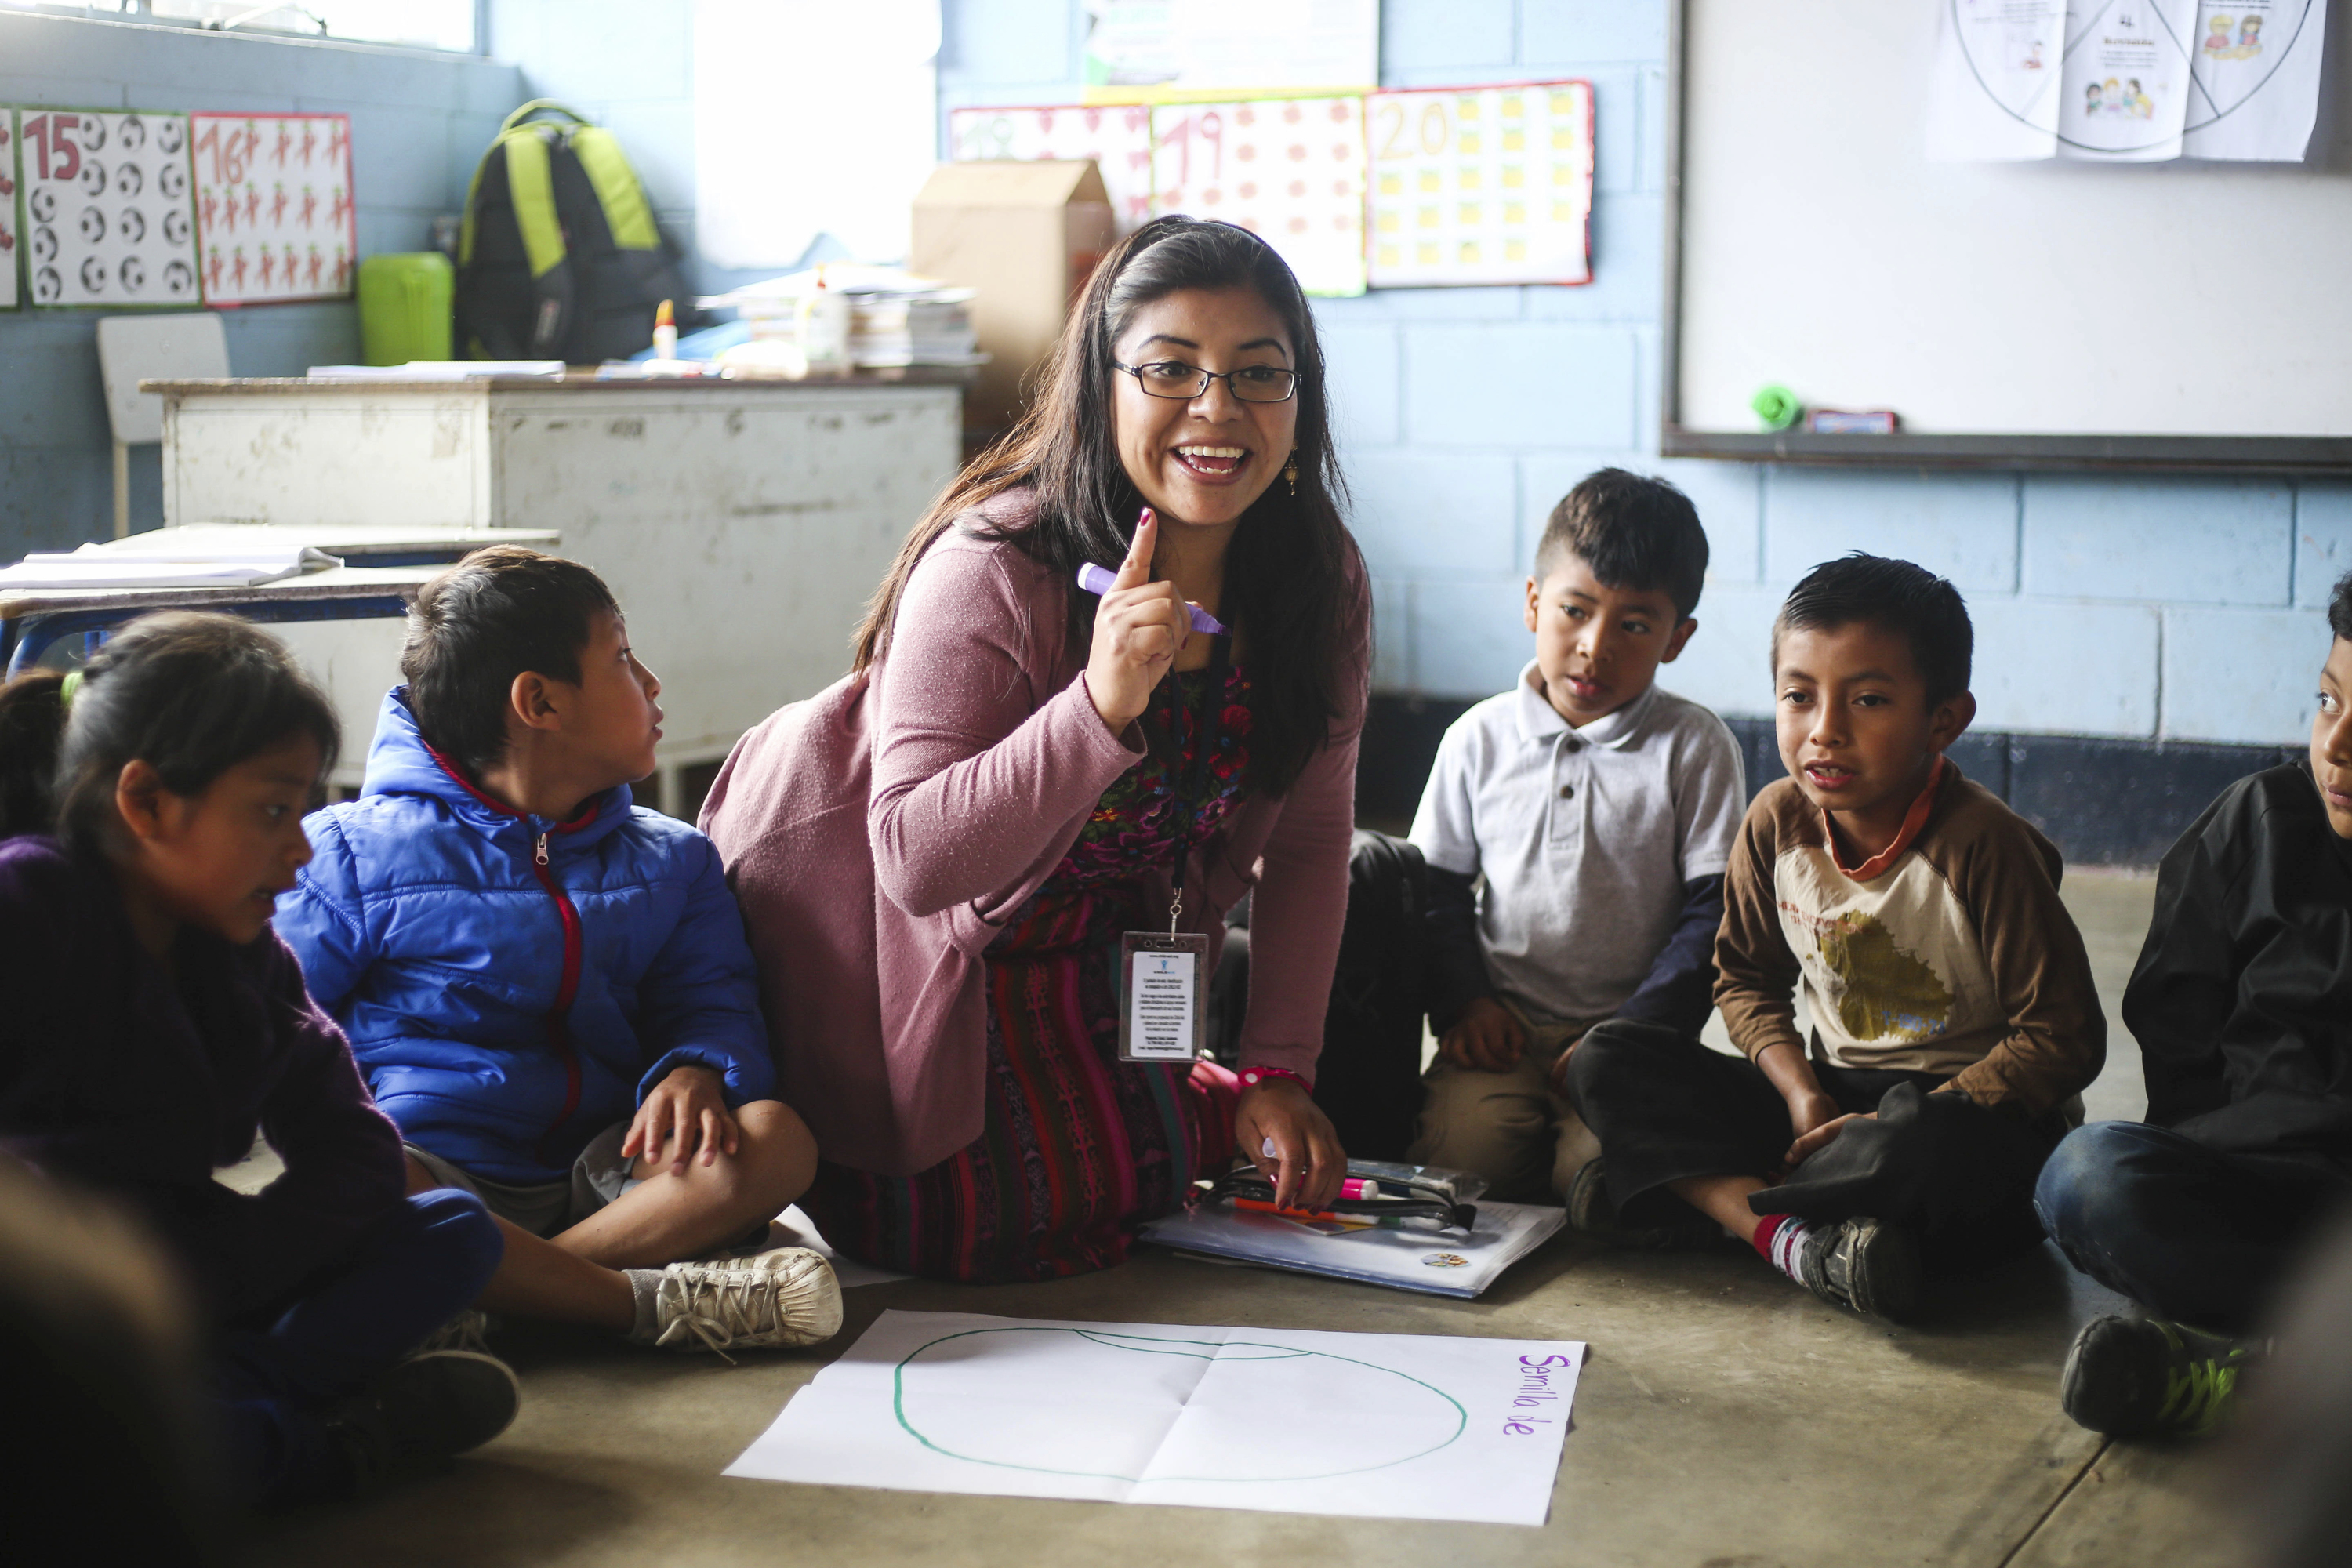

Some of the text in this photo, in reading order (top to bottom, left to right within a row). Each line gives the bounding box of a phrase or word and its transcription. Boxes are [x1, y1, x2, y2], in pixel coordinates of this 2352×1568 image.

[24, 114, 80, 180] 15
[199, 123, 243, 184] 16
[1160, 112, 1221, 183] 19
[1377, 102, 1448, 160] 20
[1503, 1355, 1571, 1436] Semilla de
